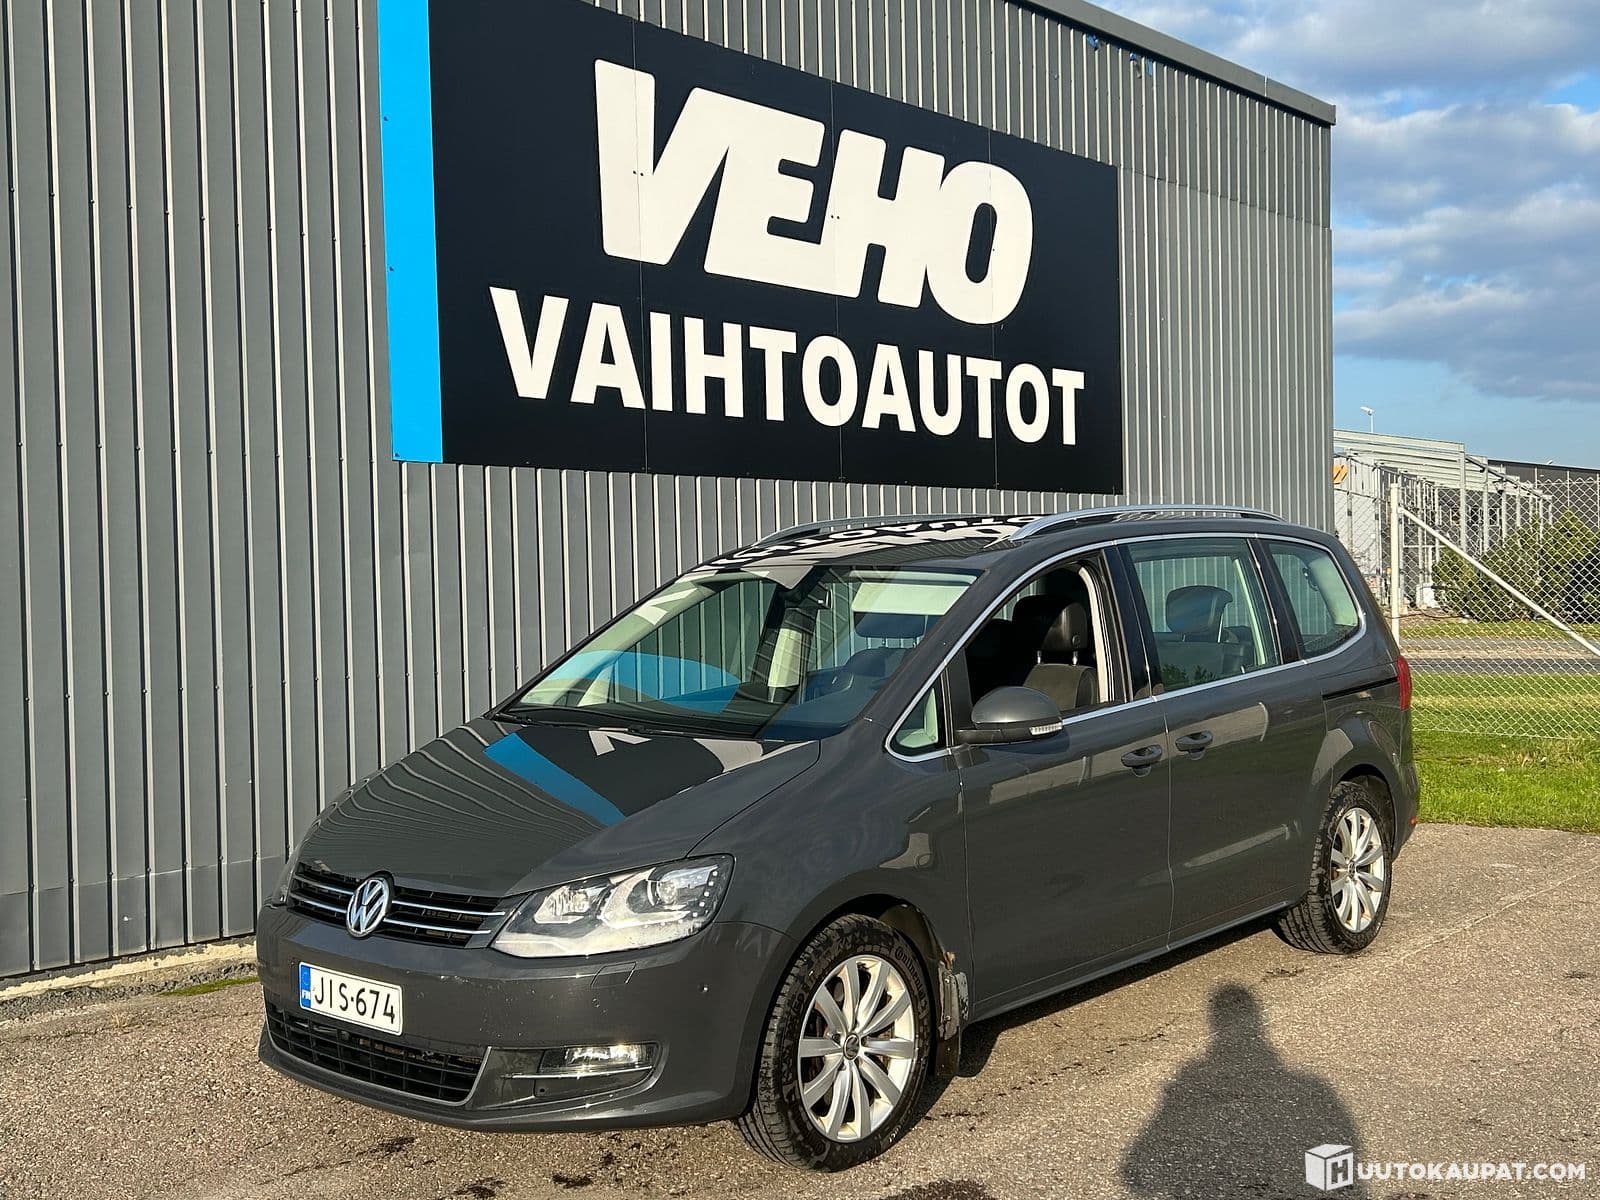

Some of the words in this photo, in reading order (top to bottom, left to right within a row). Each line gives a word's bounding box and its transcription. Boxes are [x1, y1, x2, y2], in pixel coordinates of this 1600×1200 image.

[595, 58, 1034, 325] VEHO
[489, 286, 1085, 445] VAIHTOAUTOT
[314, 976, 395, 1024] JIS-674
